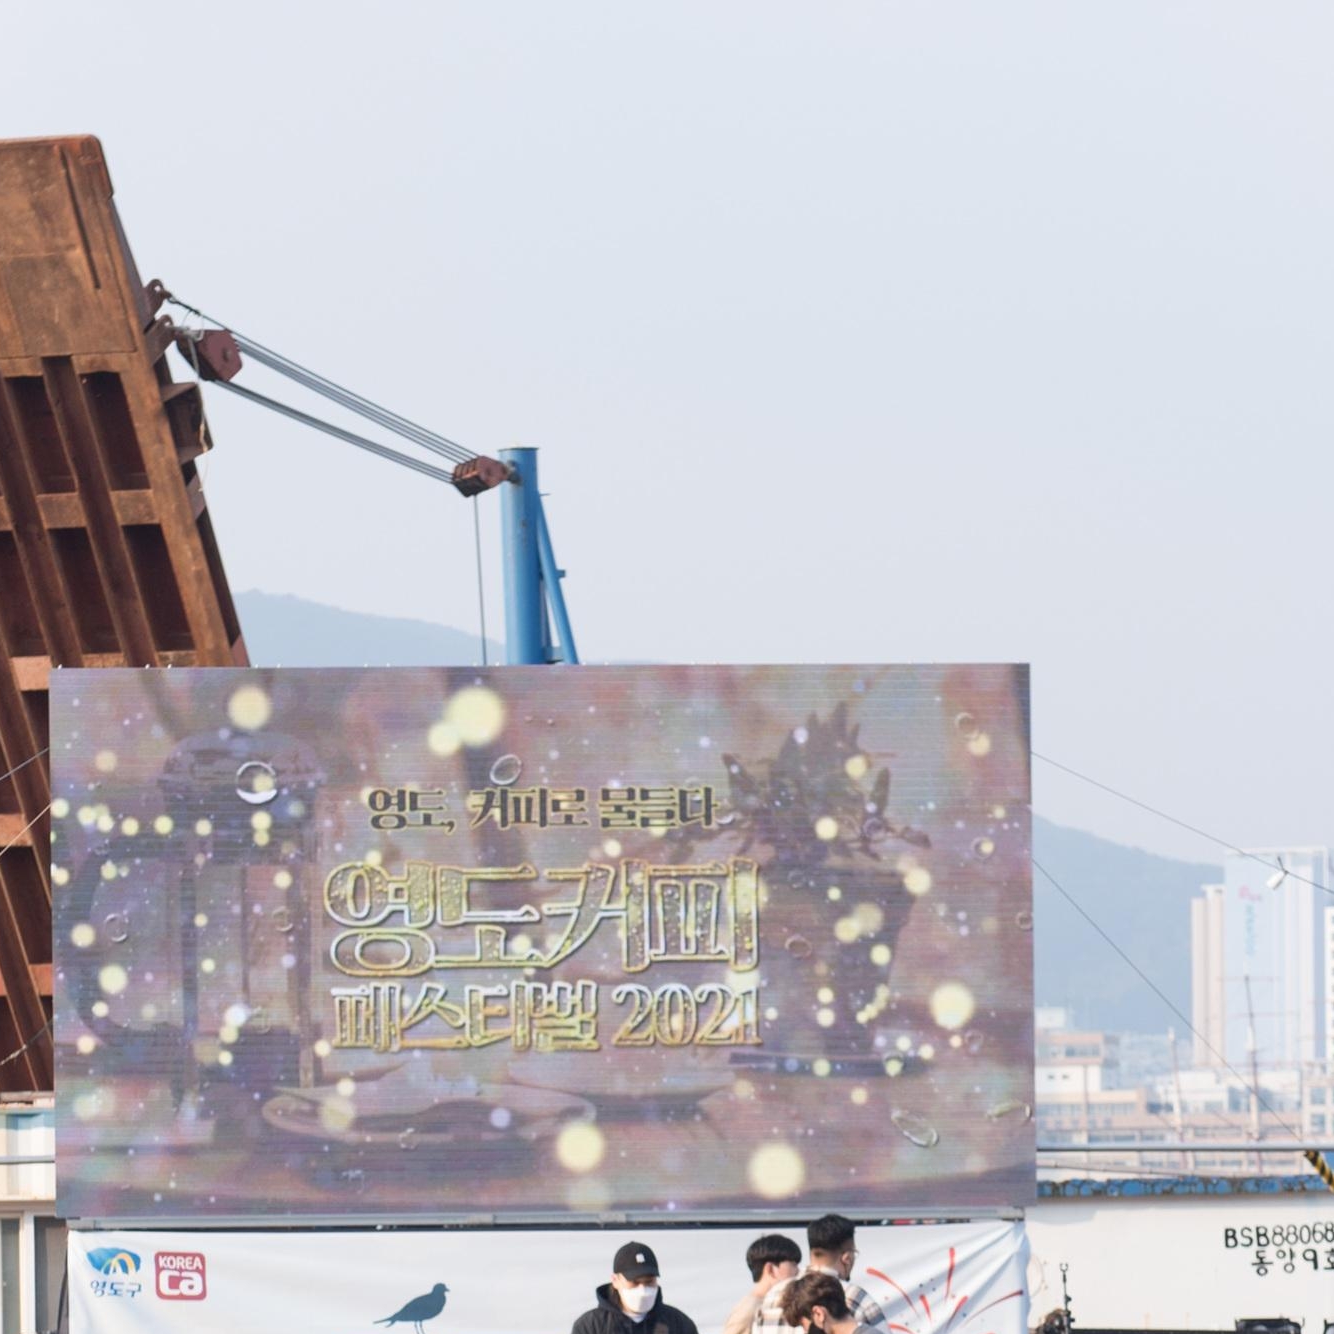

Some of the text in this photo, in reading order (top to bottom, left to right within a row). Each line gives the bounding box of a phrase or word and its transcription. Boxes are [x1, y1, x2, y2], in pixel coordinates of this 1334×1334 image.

[367, 786, 718, 833] 영도, 커피로 물들다
[323, 858, 760, 978] 영도커피
[330, 980, 763, 1052] 페스티벌 2021
[158, 1255, 203, 1270] KOREA
[90, 1279, 142, 1298] 영도구
